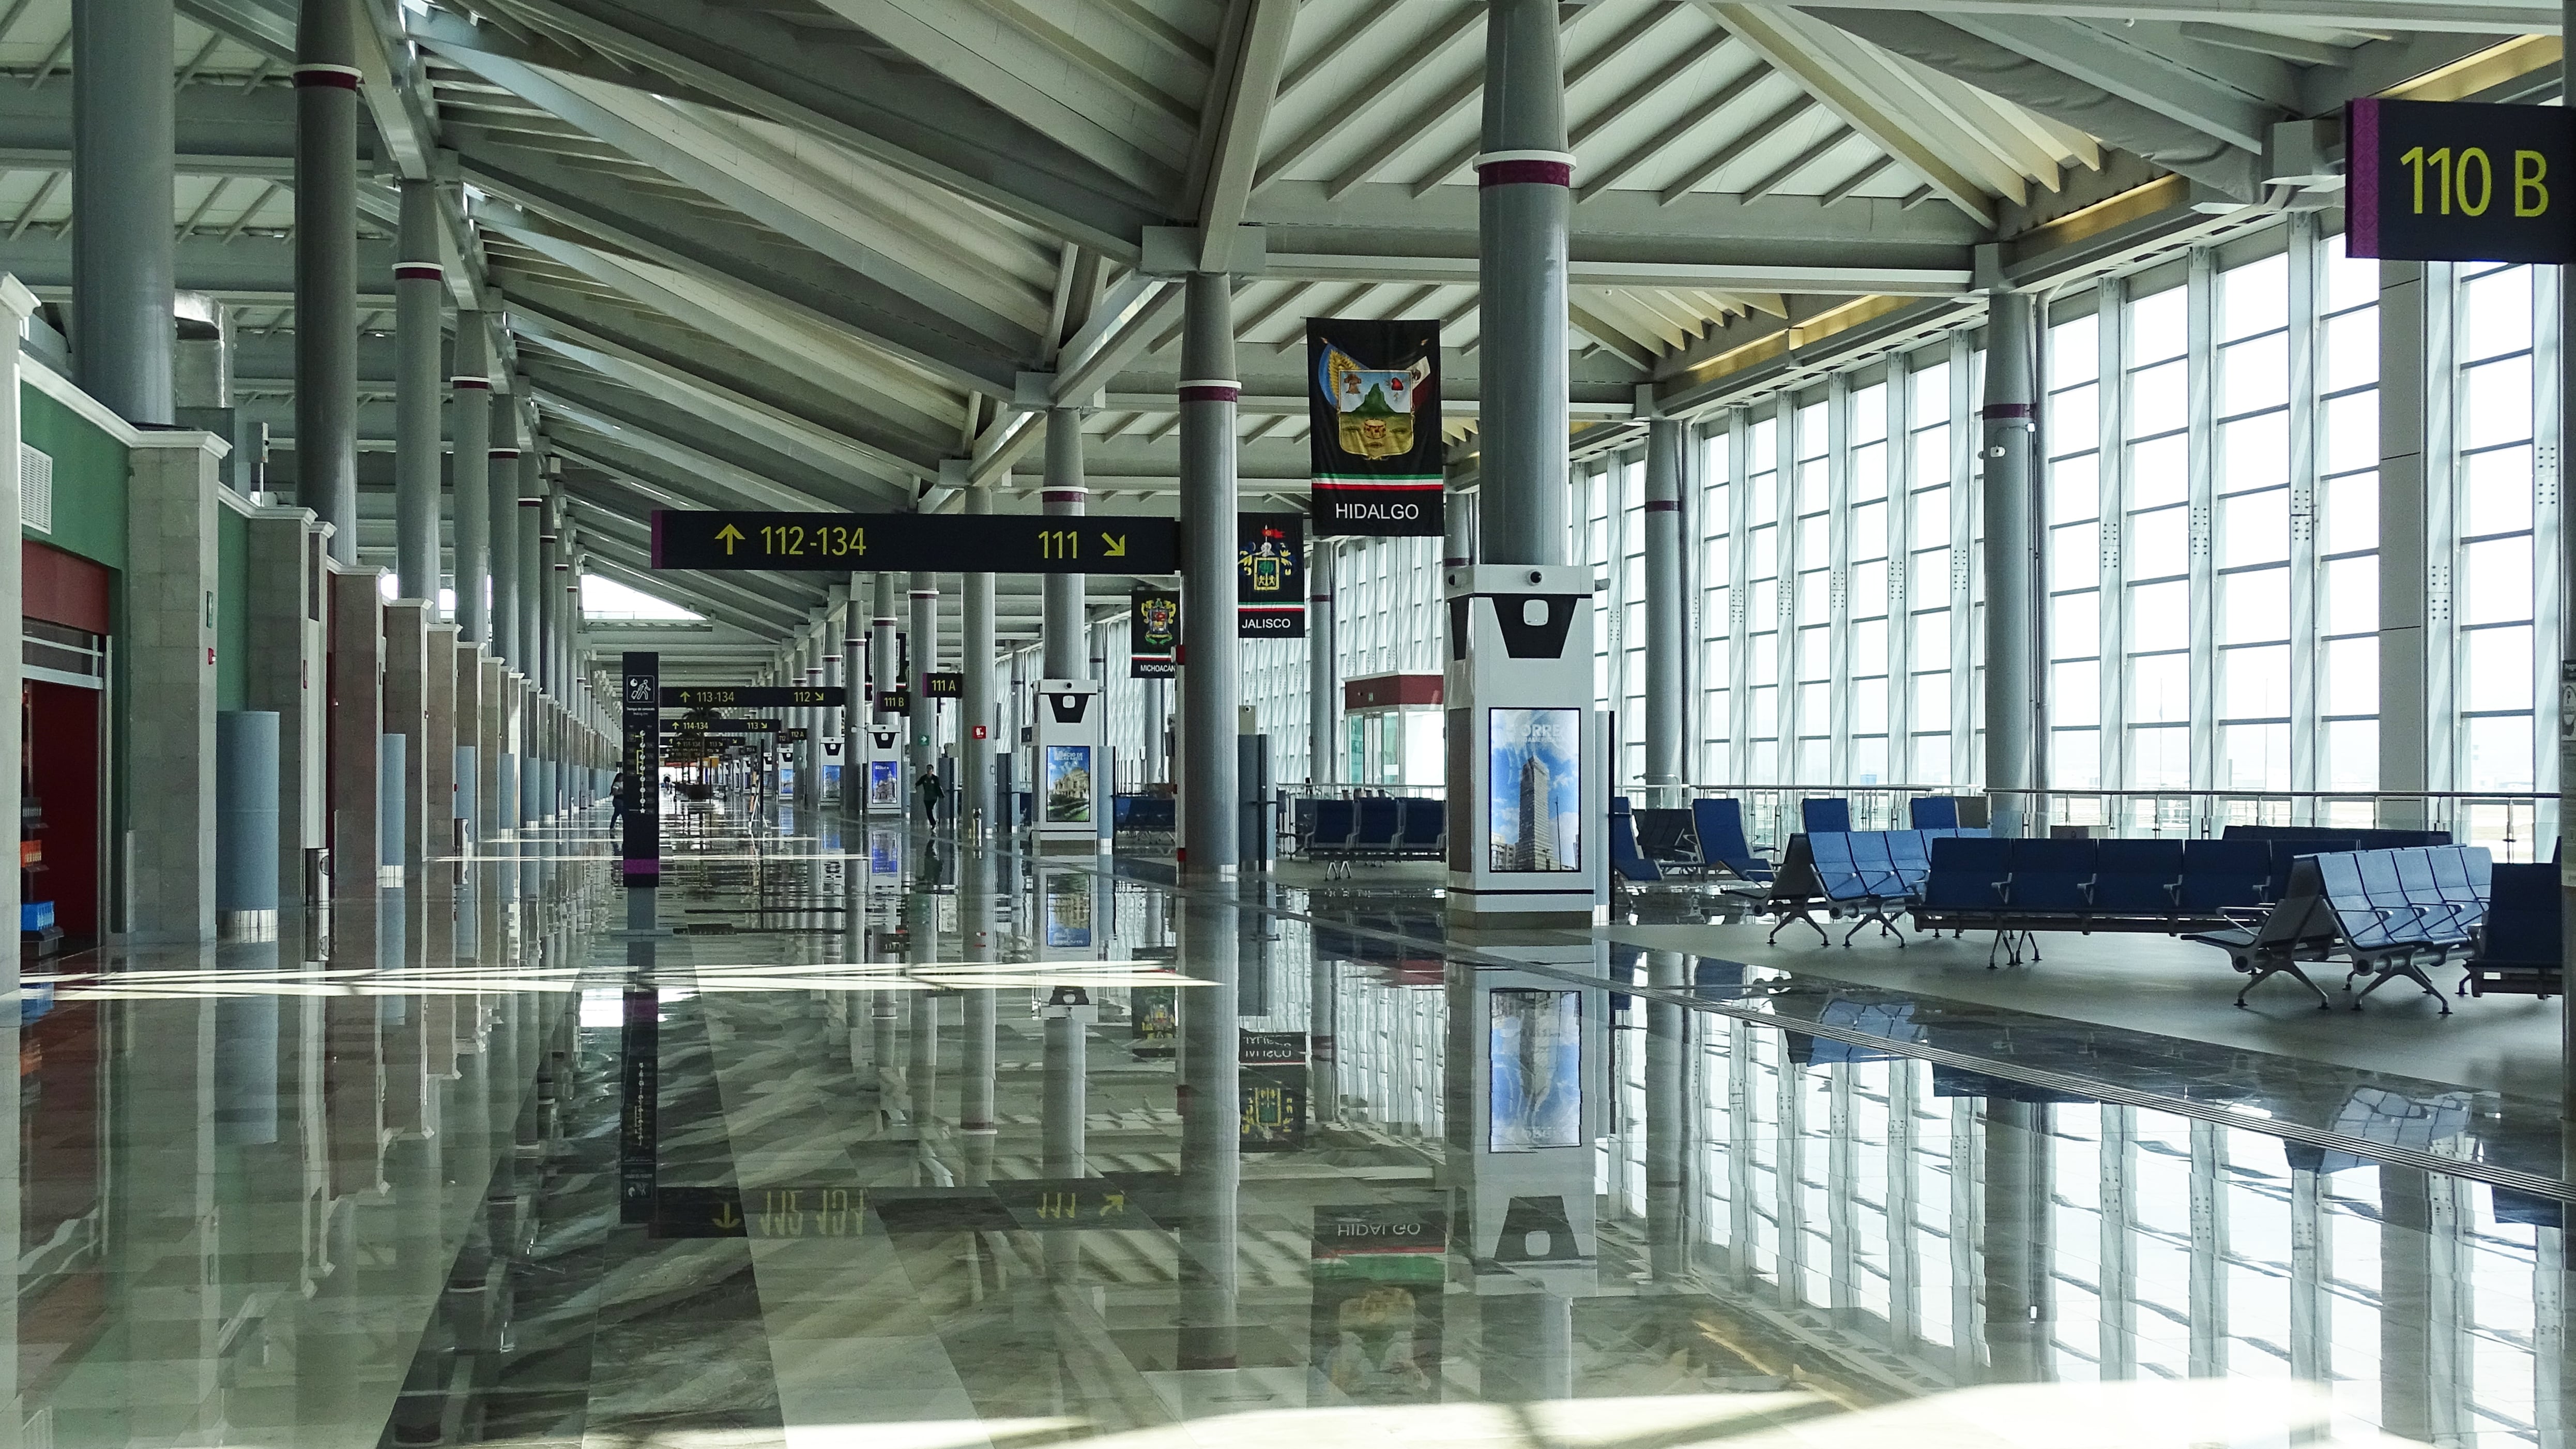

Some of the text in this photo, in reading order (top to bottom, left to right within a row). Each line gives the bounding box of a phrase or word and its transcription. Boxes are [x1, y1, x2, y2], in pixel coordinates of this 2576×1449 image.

[2400, 146, 2549, 217] 110 B
[1335, 503, 1419, 520] HIDALGO
[760, 526, 866, 556] 112-134
[1038, 531, 1077, 559] 111
[1242, 618, 1291, 629] JALISCO
[932, 680, 956, 691] 111 A
[696, 691, 734, 702] 113-134
[794, 691, 811, 702] 112
[884, 697, 904, 707] 111 B
[1518, 723, 1561, 736] ORRE
